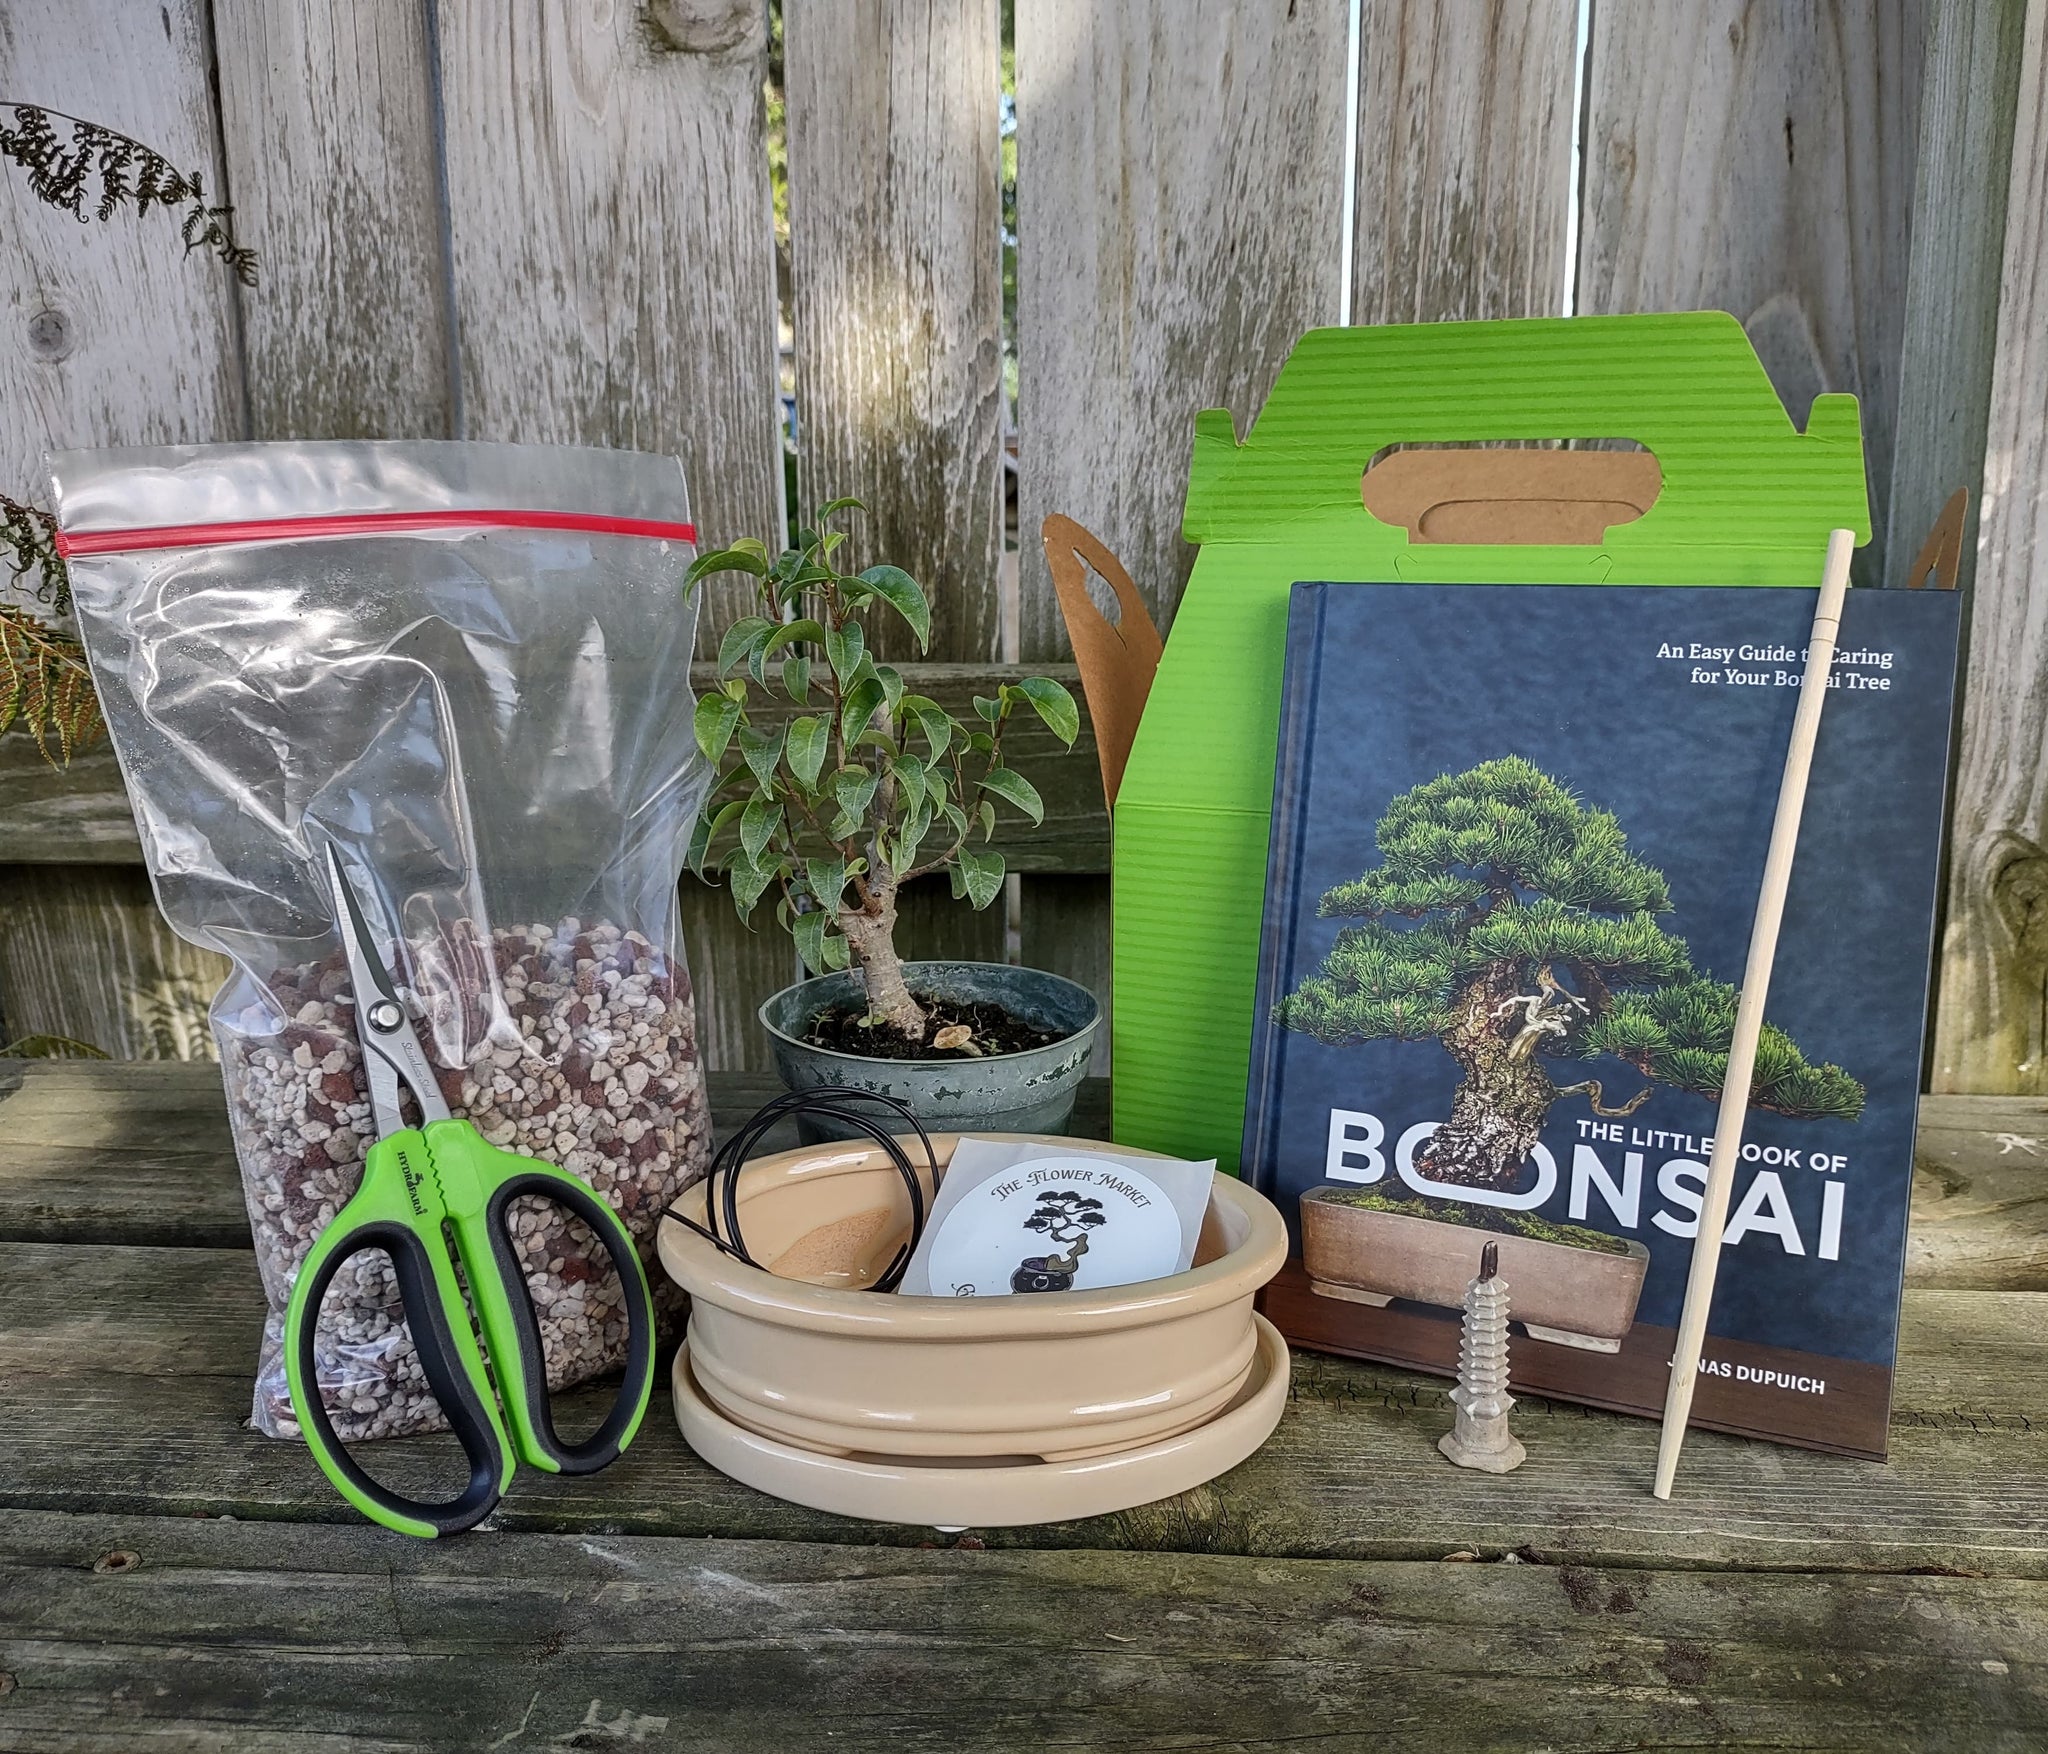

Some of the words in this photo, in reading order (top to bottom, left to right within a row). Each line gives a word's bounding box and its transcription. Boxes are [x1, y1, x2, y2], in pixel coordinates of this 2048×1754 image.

[1656, 642, 1685, 659] An
[1688, 643, 1736, 664] Easy
[1738, 644, 1796, 662] Guide
[1690, 667, 1721, 684] for
[1724, 668, 1770, 686] Your
[1773, 670, 1841, 688] Boai
[1845, 672, 1891, 690] Tree
[1576, 1119, 1624, 1143] THE
[1631, 1127, 1715, 1156] LITTLE
[1736, 1143, 1802, 1169] OOK
[1809, 1152, 1848, 1173] OF
[990, 1179, 1023, 1202] THE
[1026, 1167, 1094, 1187] FLOWER
[1093, 1172, 1152, 1209] MARKET
[1324, 1107, 1846, 1262] BONSAI
[1666, 1353, 1732, 1378] JNAS
[1736, 1365, 1825, 1396] DUPUICH
